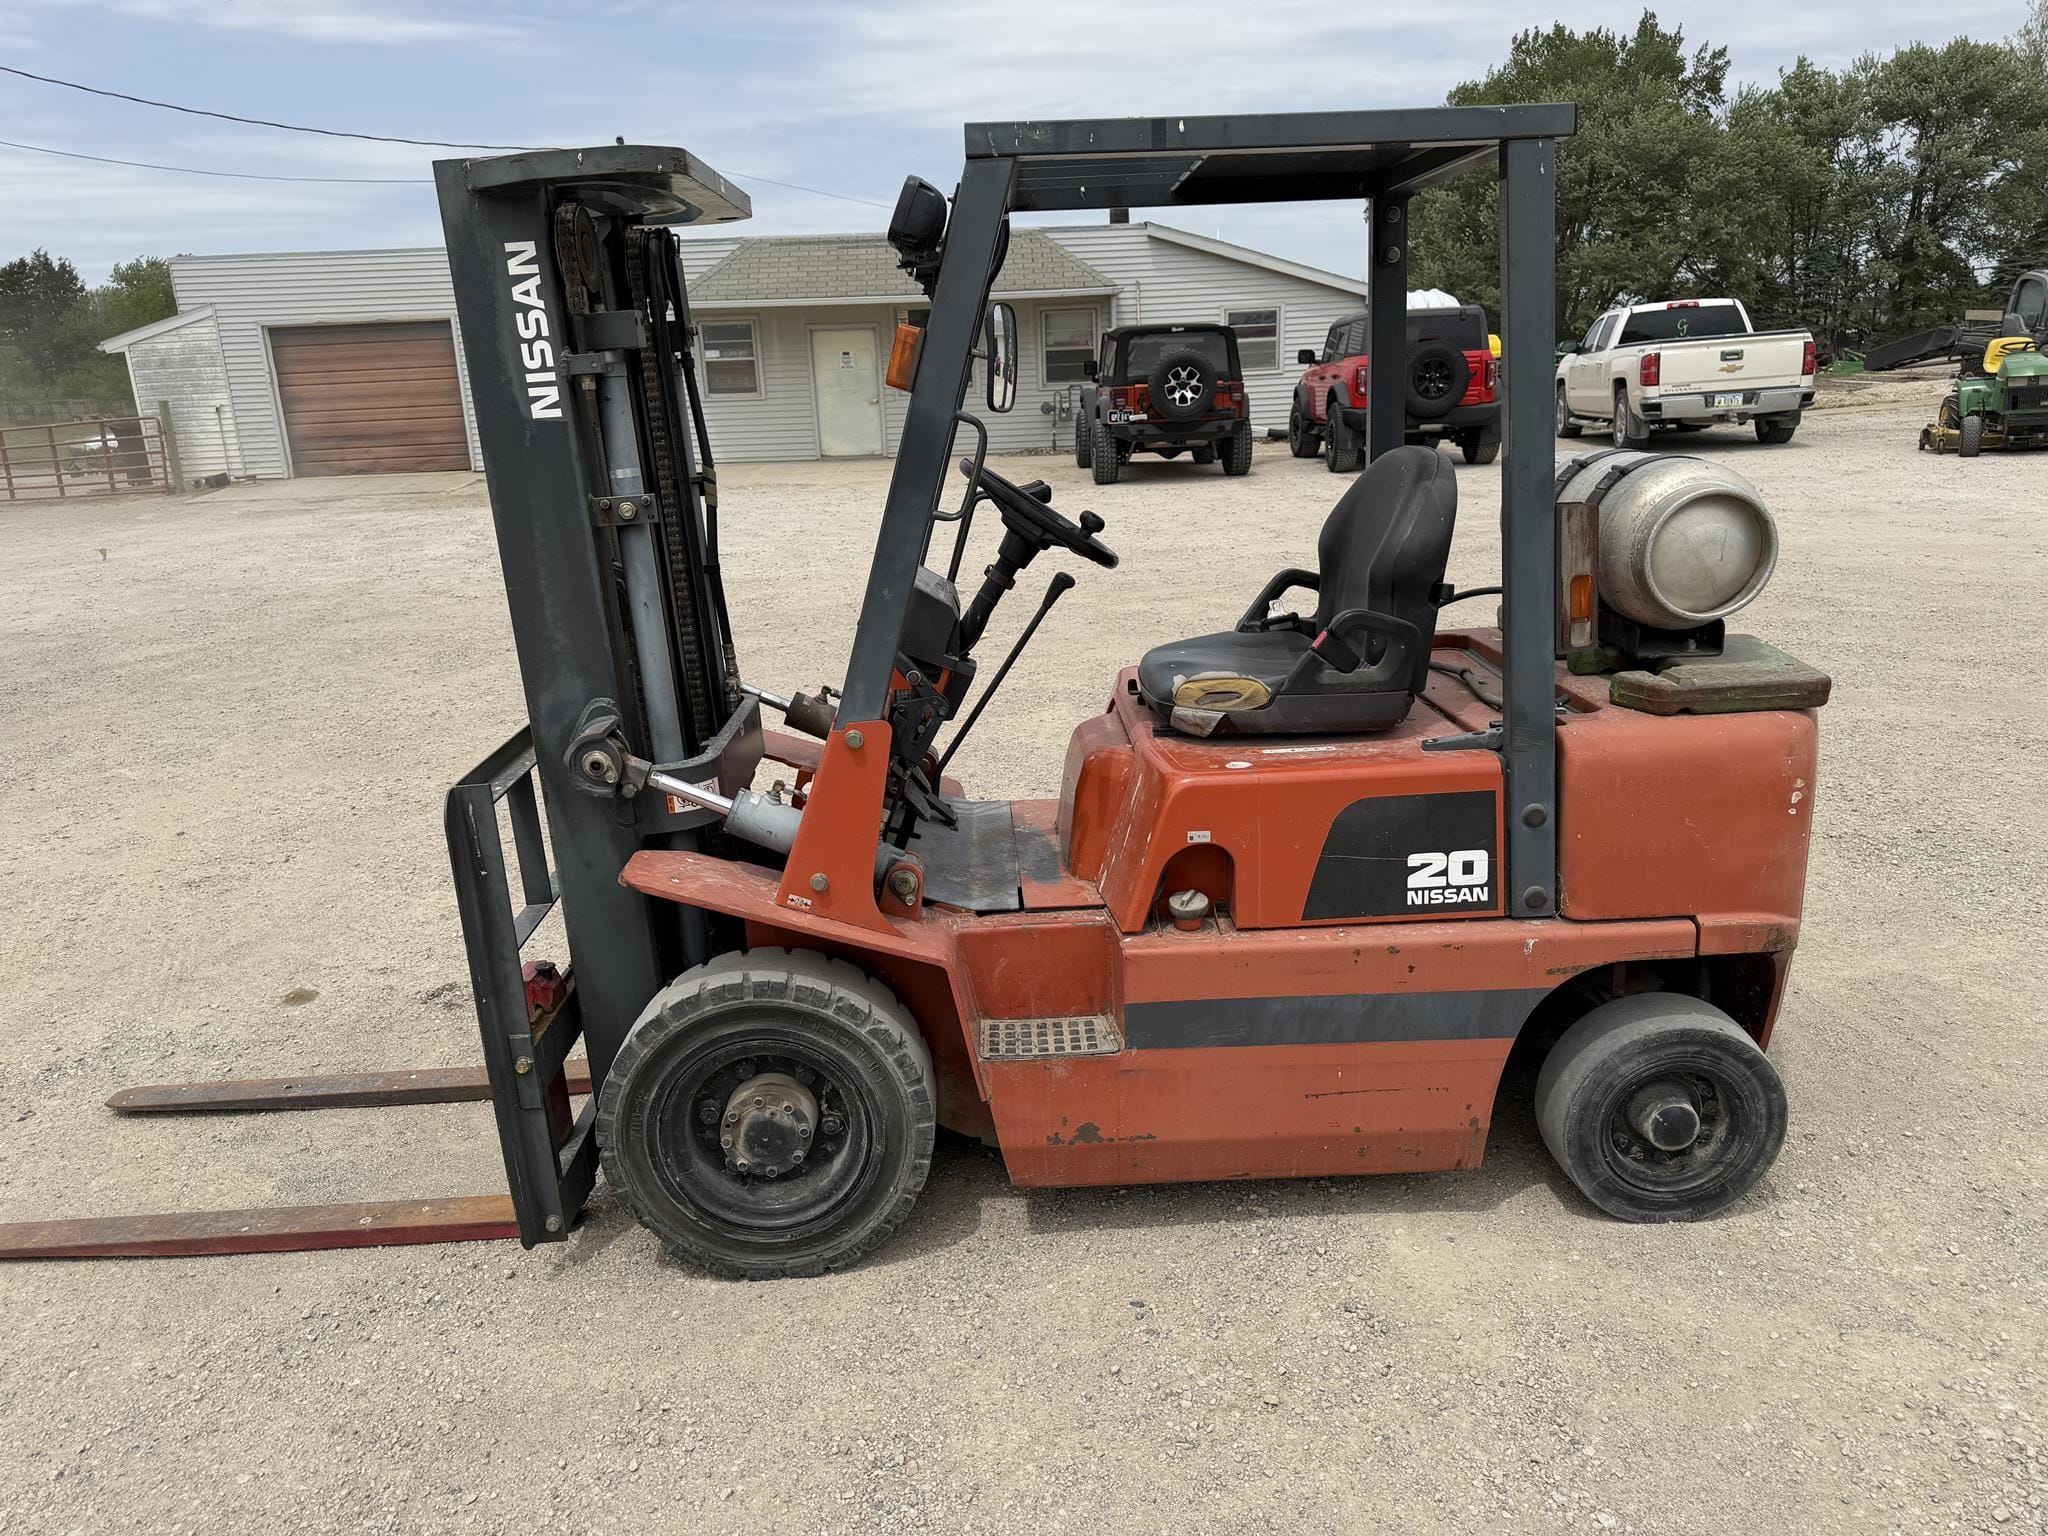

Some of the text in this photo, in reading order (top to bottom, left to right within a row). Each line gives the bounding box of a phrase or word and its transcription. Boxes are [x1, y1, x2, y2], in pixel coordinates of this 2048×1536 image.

[504, 241, 562, 419] NISSAN
[1407, 850, 1488, 888] 20
[1407, 887, 1488, 906] NISSAN
